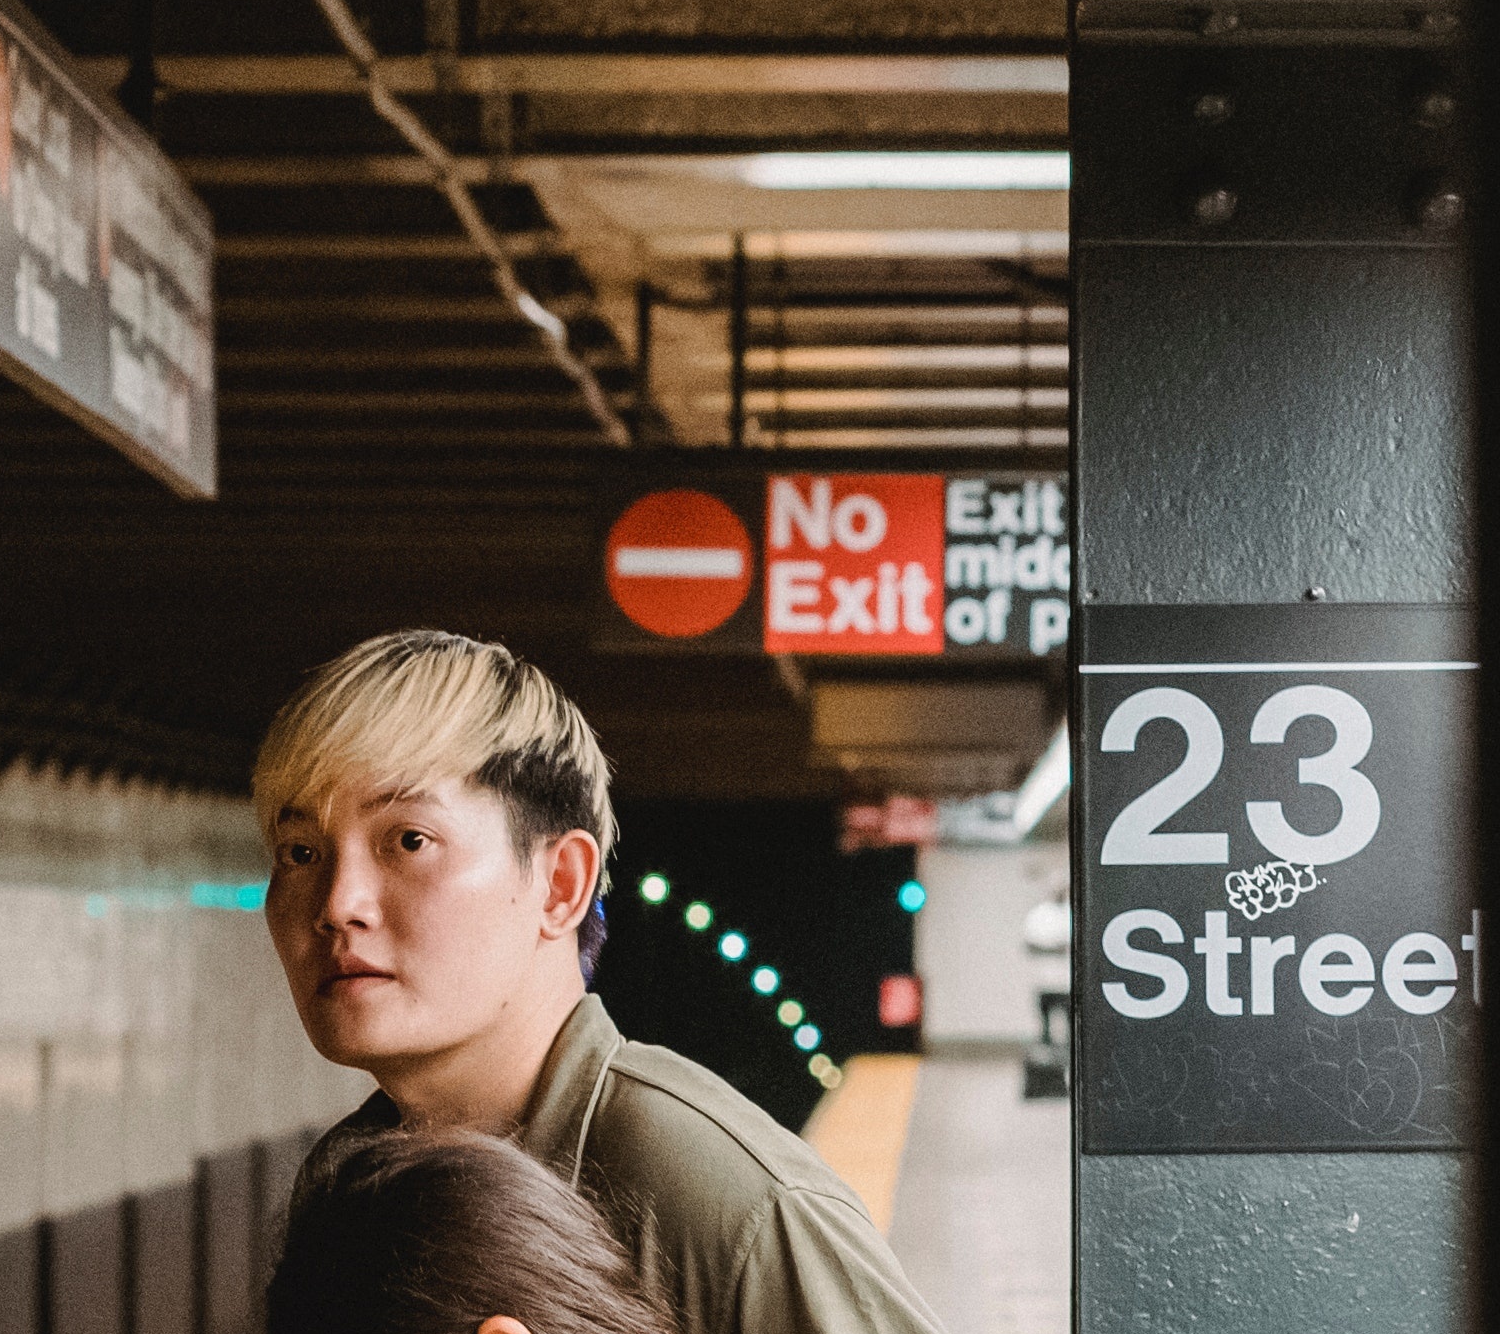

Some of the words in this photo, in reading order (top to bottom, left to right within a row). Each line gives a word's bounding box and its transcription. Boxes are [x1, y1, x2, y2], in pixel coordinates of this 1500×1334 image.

[768, 478, 889, 554] No
[947, 480, 1067, 535] Exit
[767, 560, 937, 637] Exit
[945, 588, 1011, 645] of
[1100, 685, 1381, 866] 23
